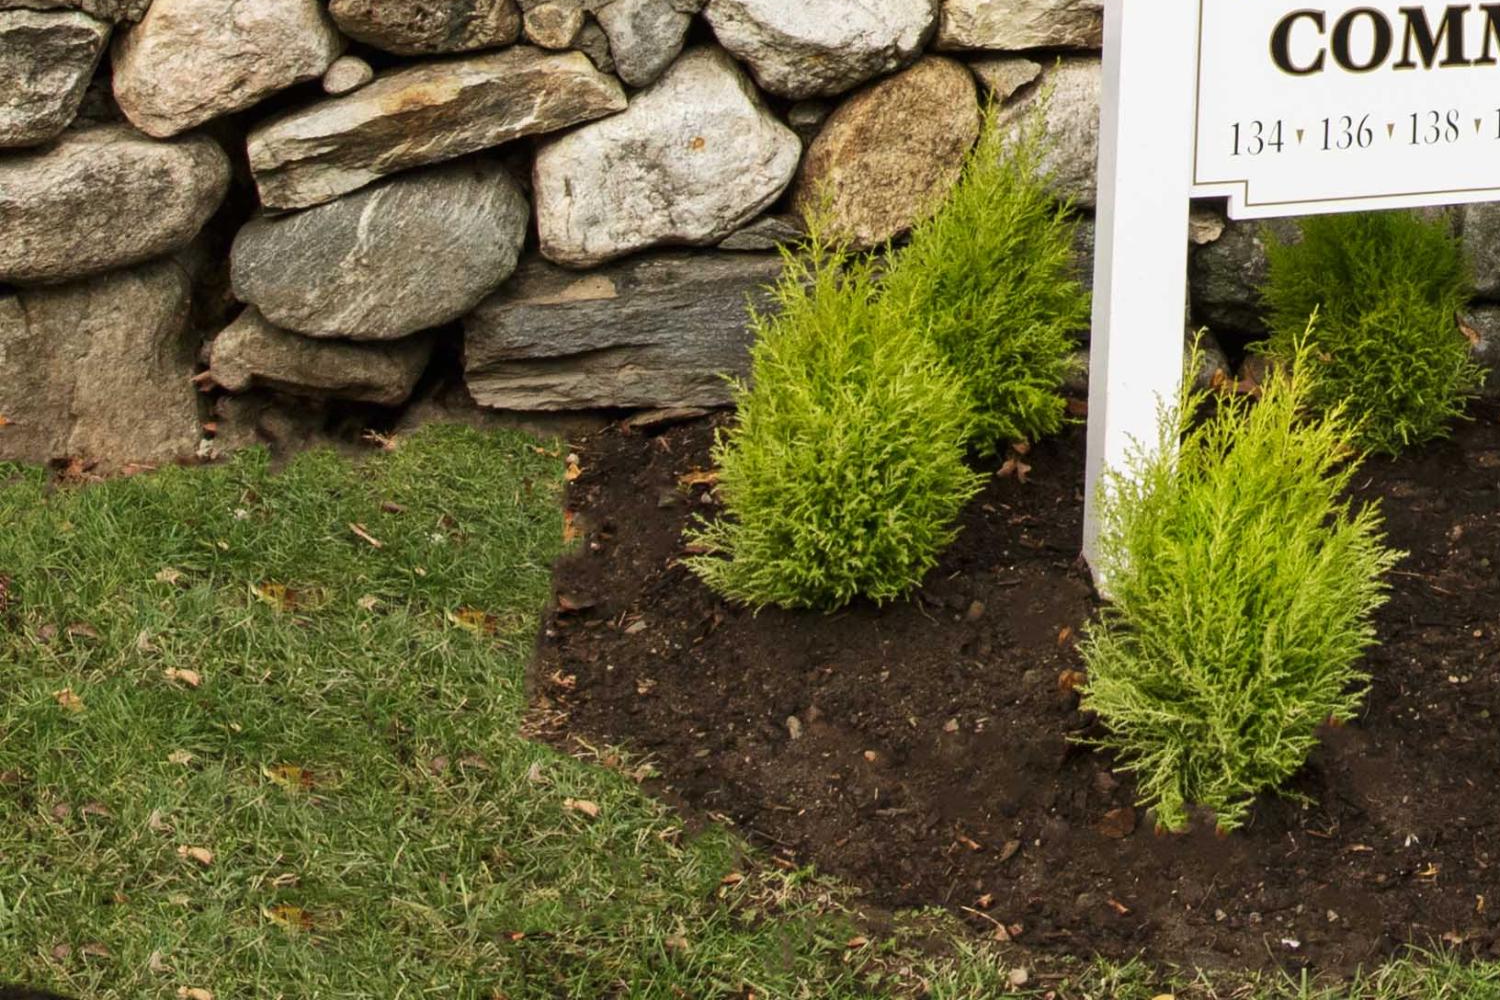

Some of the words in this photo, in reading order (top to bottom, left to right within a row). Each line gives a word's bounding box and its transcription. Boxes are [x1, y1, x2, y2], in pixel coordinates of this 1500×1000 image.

[1229, 119, 1285, 157] 134
[1319, 113, 1374, 152] 136
[1408, 108, 1460, 146] 138
